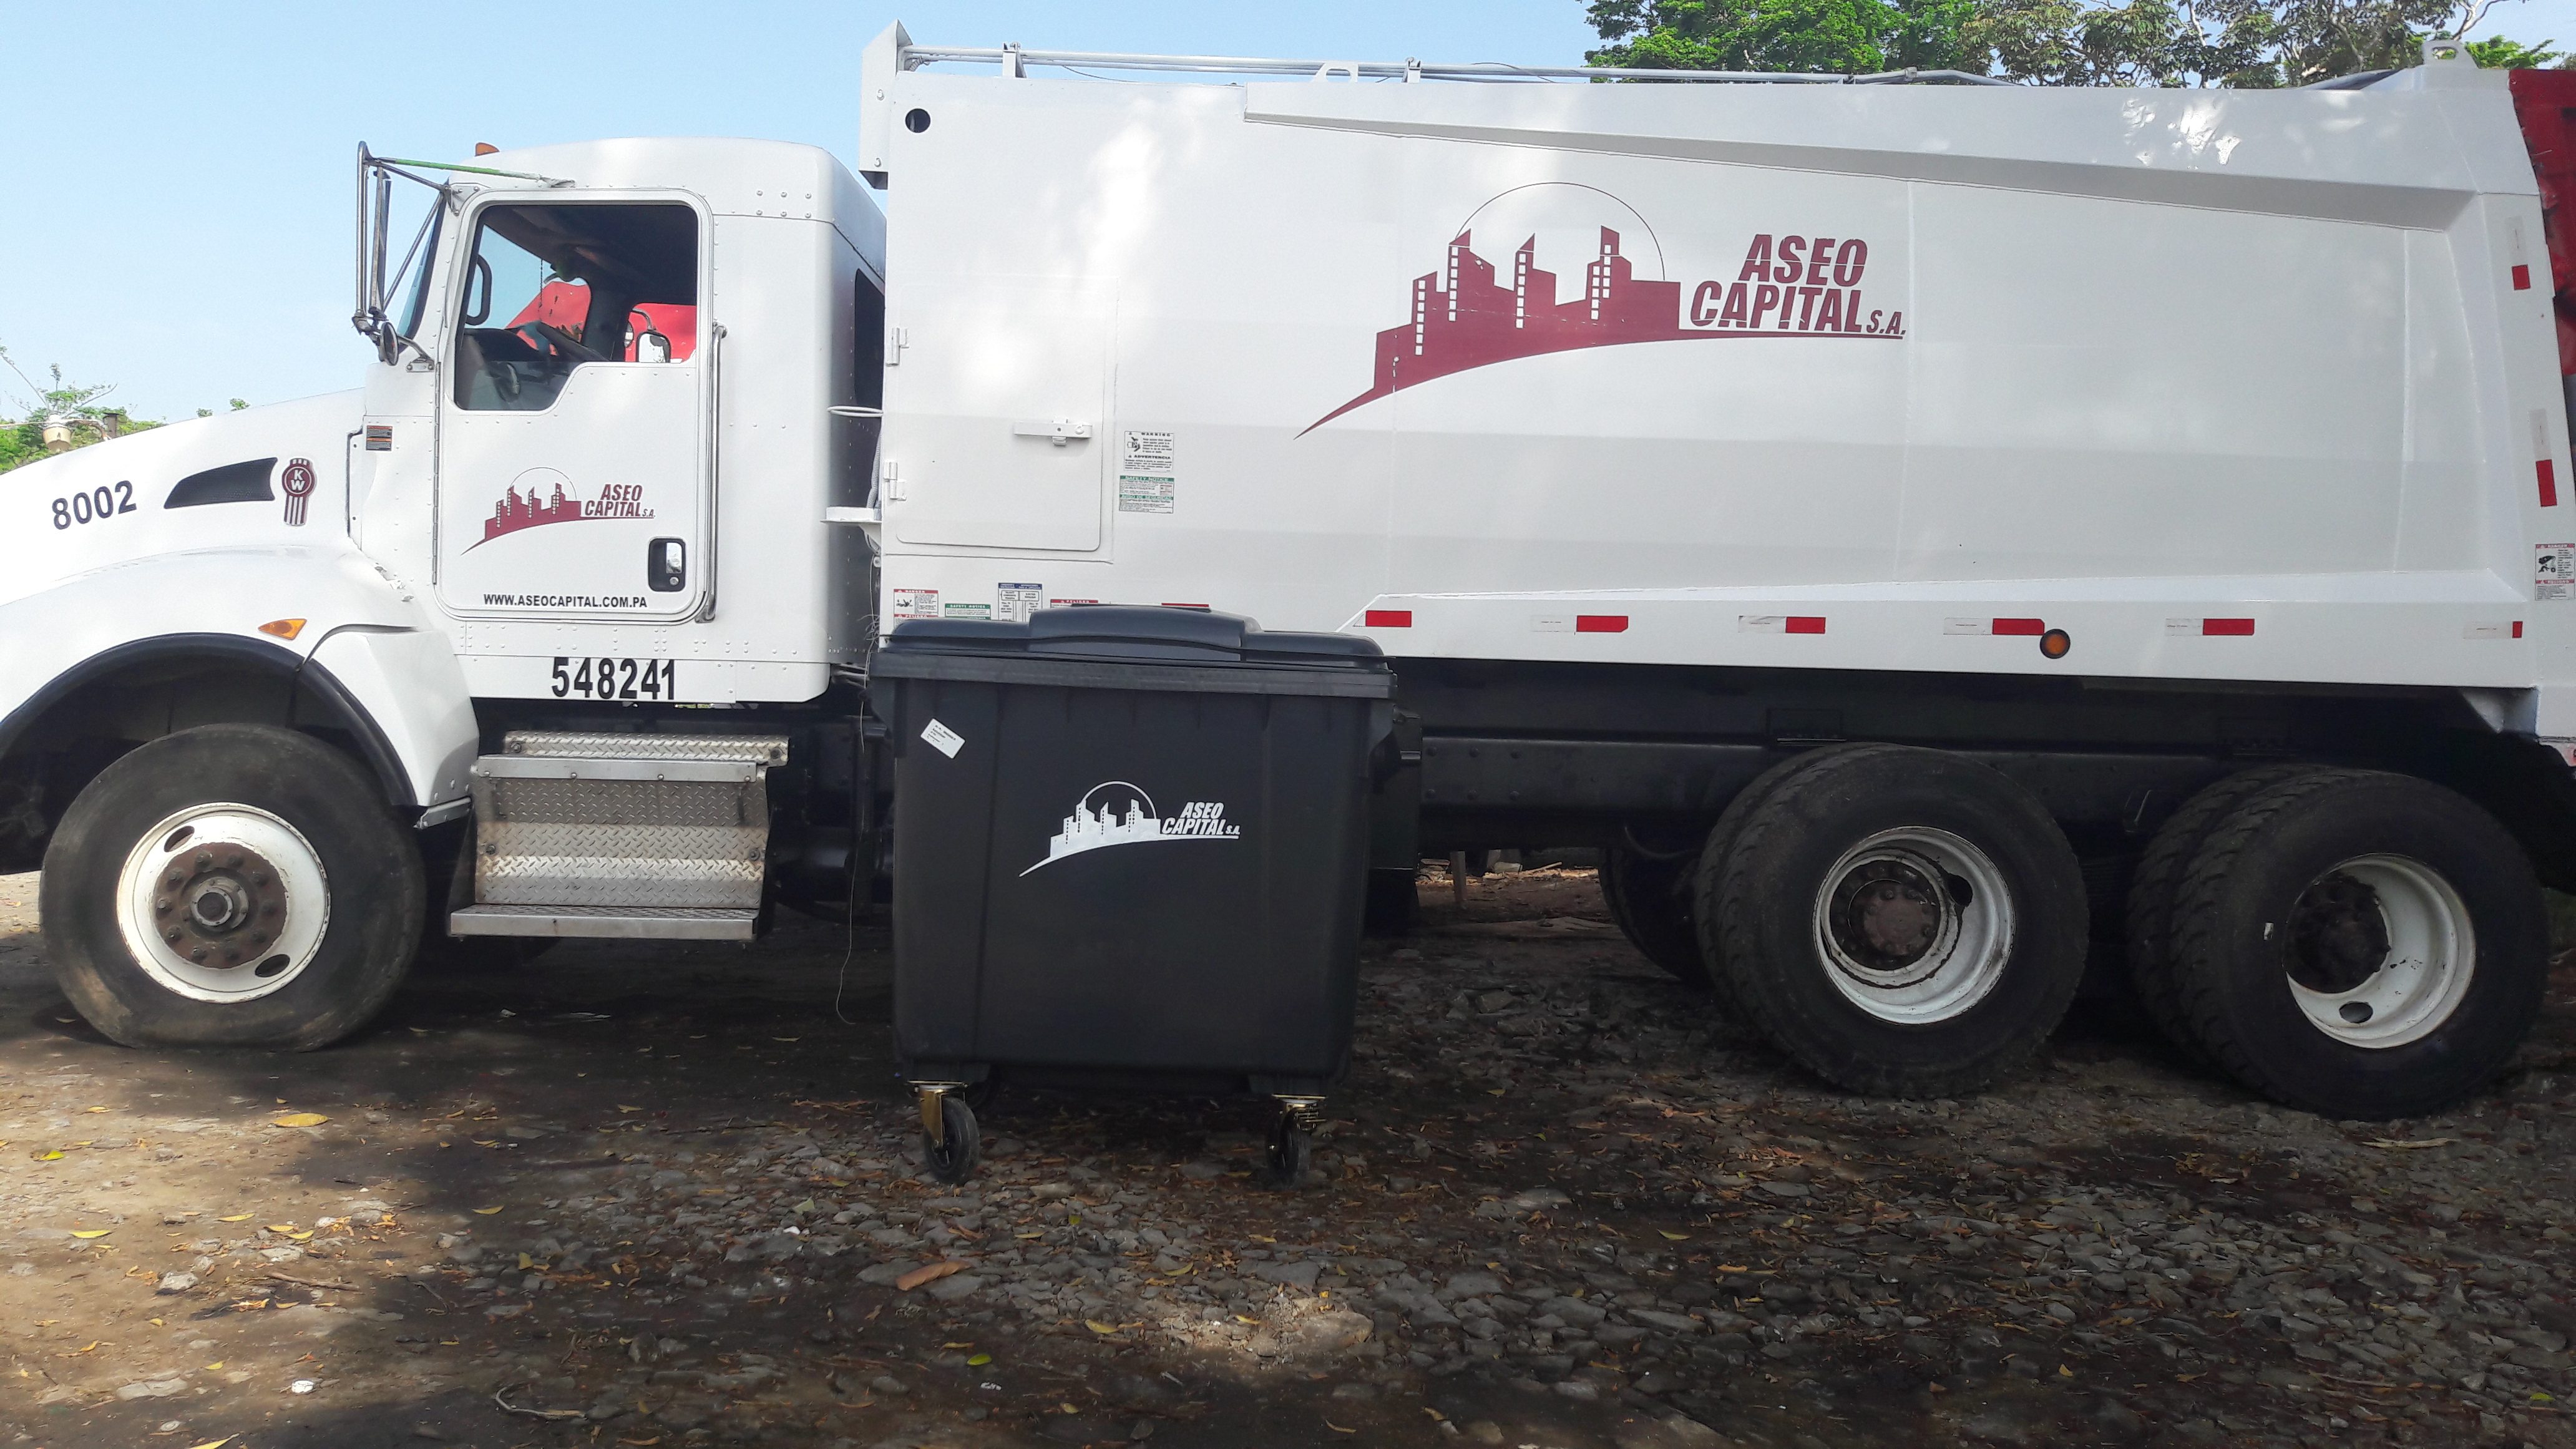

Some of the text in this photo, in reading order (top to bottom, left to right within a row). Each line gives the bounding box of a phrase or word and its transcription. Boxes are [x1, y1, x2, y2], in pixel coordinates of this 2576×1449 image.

[1738, 233, 1868, 287] ASEO
[1690, 280, 1906, 335] CAPITAL S.A.
[600, 484, 643, 501] ASEO
[52, 480, 137, 530] 8002
[585, 500, 656, 517] CAPITAL S.A.
[484, 593, 648, 608] WWW.ASEOCAPITAL.COM.PA
[552, 656, 675, 700] 548241
[1179, 801, 1224, 819] ASEO
[1161, 817, 1226, 835] CAPITAL
